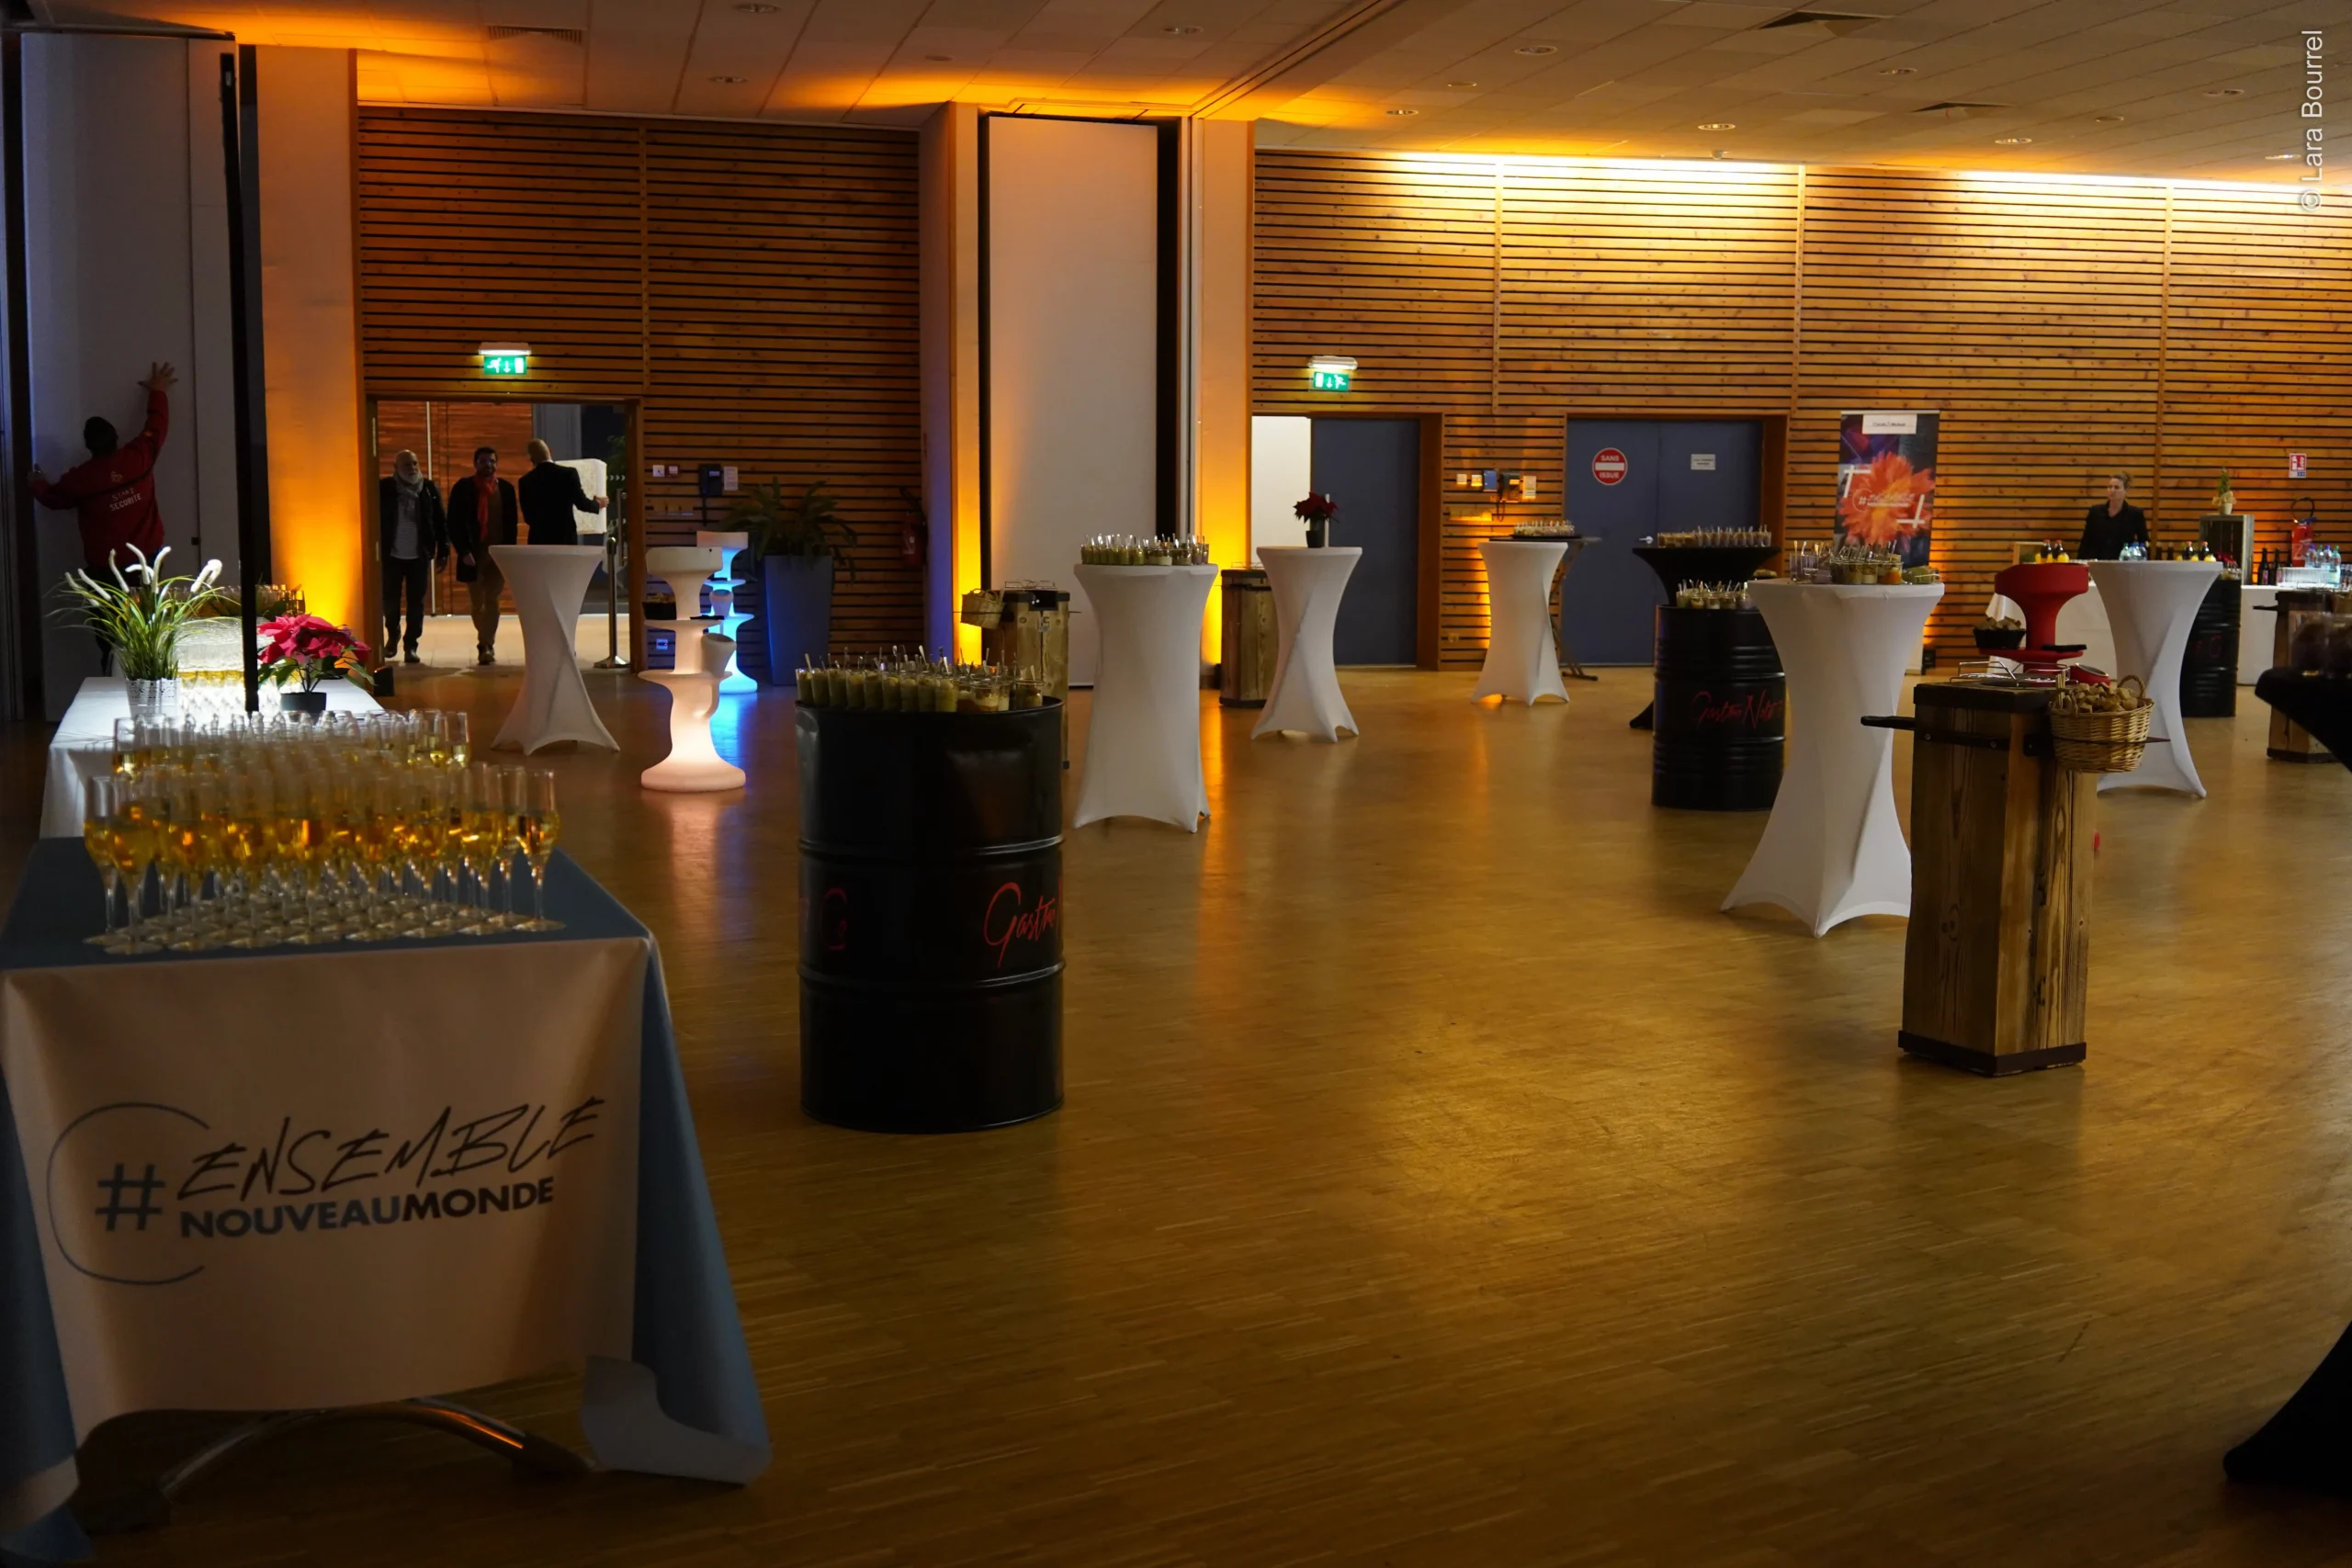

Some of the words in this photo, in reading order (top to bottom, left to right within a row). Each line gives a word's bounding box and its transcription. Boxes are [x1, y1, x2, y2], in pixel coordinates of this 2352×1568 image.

[108, 492, 142, 512] SECURITE
[176, 1096, 605, 1201] ENSEMBLE
[180, 1157, 556, 1239] NOUVEAUMONDE
